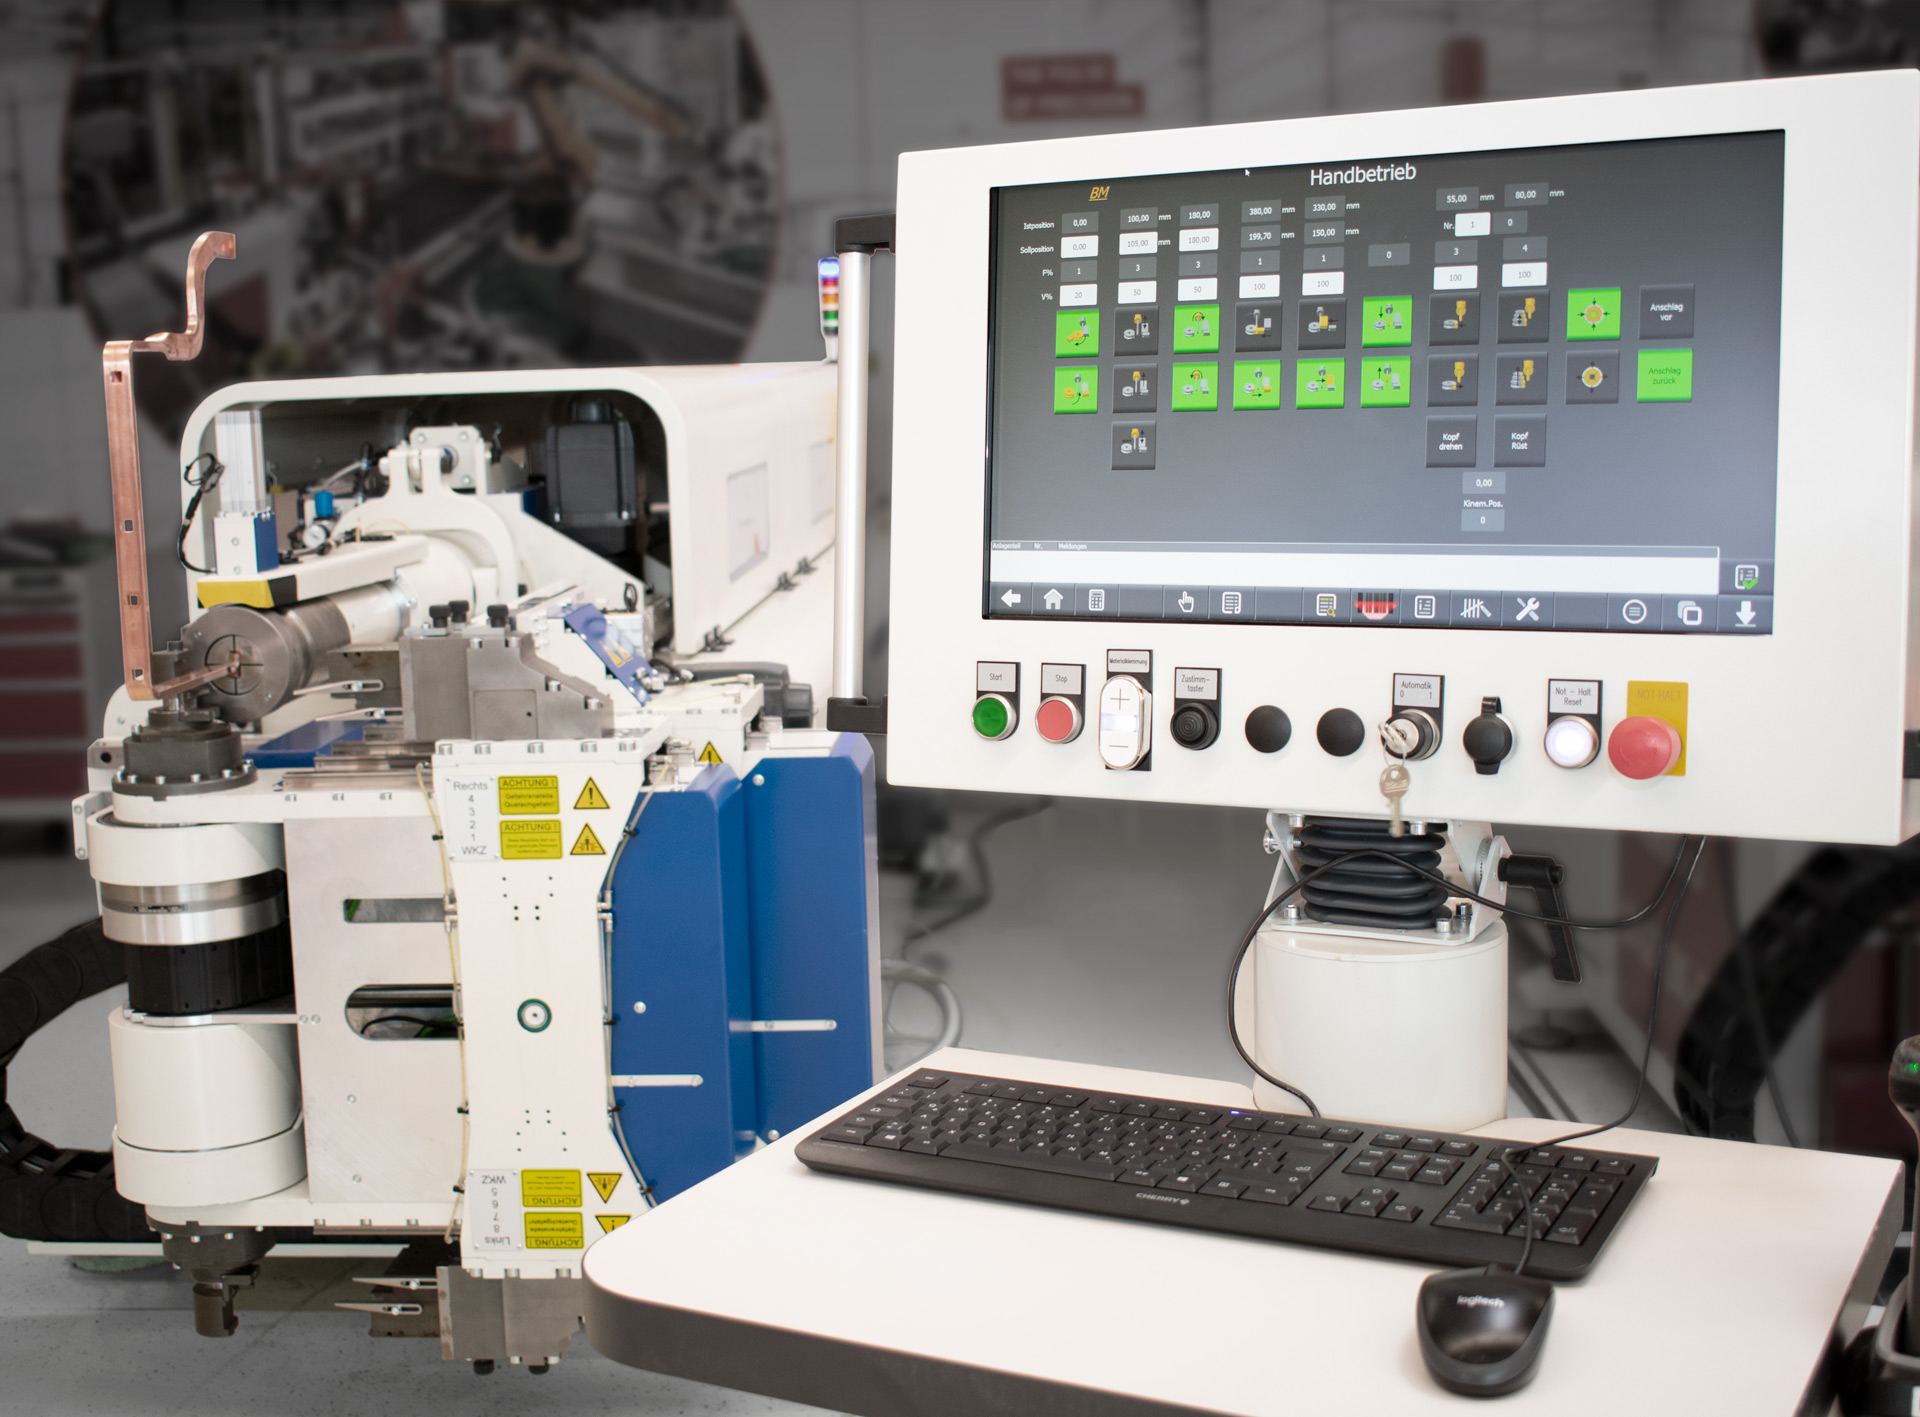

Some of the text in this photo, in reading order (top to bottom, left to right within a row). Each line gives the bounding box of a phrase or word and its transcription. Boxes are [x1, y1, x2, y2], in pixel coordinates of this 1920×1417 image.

[1310, 163, 1416, 186] Handbetrieb
[1089, 185, 1111, 202] BM
[1446, 189, 1565, 204] 55,00 mm 80,00 mm
[1023, 221, 1055, 231] Istposition
[1072, 218, 1088, 228] 0,00
[1127, 213, 1150, 224] 100,00
[1188, 210, 1212, 220] 180,00
[1248, 206, 1273, 217] 380,00
[1281, 206, 1296, 214] mm
[1312, 202, 1337, 213] 330,00
[1345, 202, 1361, 210] mm
[1443, 221, 1455, 230] Nr.
[1507, 217, 1514, 227] 0
[1019, 245, 1055, 255] Sollposition
[1072, 242, 1087, 252] 0,00
[1127, 239, 1149, 248] 105,00
[1188, 235, 1211, 245] 180,00
[1248, 231, 1272, 242] 199,70
[1280, 231, 1296, 239] mm
[1312, 227, 1336, 238] 150,00
[1345, 228, 1360, 236] mm
[1076, 267, 1082, 275] 1
[1135, 263, 1141, 272] 3
[1195, 260, 1201, 269] 3
[1257, 257, 1263, 266] 1
[1321, 253, 1327, 263] 1
[1386, 250, 1393, 260] 0
[1453, 247, 1460, 256] 3
[1521, 243, 1529, 253] 4
[1040, 270, 1532, 301] V% 20 50 50 100 100 100 100
[1650, 302, 1684, 313] Anschlag
[1659, 314, 1674, 322] vor
[1648, 366, 1682, 377] Anschlag
[1651, 376, 1678, 386] zurück
[1442, 432, 1460, 442] Kopf
[1511, 431, 1529, 441] Kopf
[1438, 442, 1464, 451] drehen
[1511, 441, 1529, 450] Rüst
[1475, 478, 1493, 488] 0,00
[1463, 499, 1503, 509] Kinem.Pos.
[1479, 515, 1486, 525] 0
[989, 672, 1003, 682] Start
[1055, 673, 1069, 685] Stop
[1186, 684, 1205, 693] taster
[1400, 680, 1433, 690] Automatik
[1399, 690, 1405, 699] 0
[1554, 686, 1568, 696] Not
[1580, 687, 1592, 697] Halt
[1563, 697, 1583, 707] Reset
[452, 780, 489, 791] Rechts
[502, 779, 549, 788] ACHTUNG
[467, 794, 475, 803] 4
[468, 806, 476, 817] 3
[469, 819, 477, 830] 2
[504, 823, 552, 832] ACHTUNG
[470, 832, 476, 842] 1
[460, 845, 487, 856] WKZ
[481, 1174, 507, 1185] WKZ
[490, 1187, 499, 1197] 5
[530, 1196, 578, 1206] ACHTUNG
[1136, 1192, 1181, 1204] CHERRY
[491, 1199, 500, 1210] 6
[492, 1212, 500, 1222] 7
[492, 1224, 501, 1234] 8
[484, 1235, 511, 1246] Links
[534, 1238, 580, 1247] ACHTUNG
[1457, 1295, 1506, 1309] logitech
